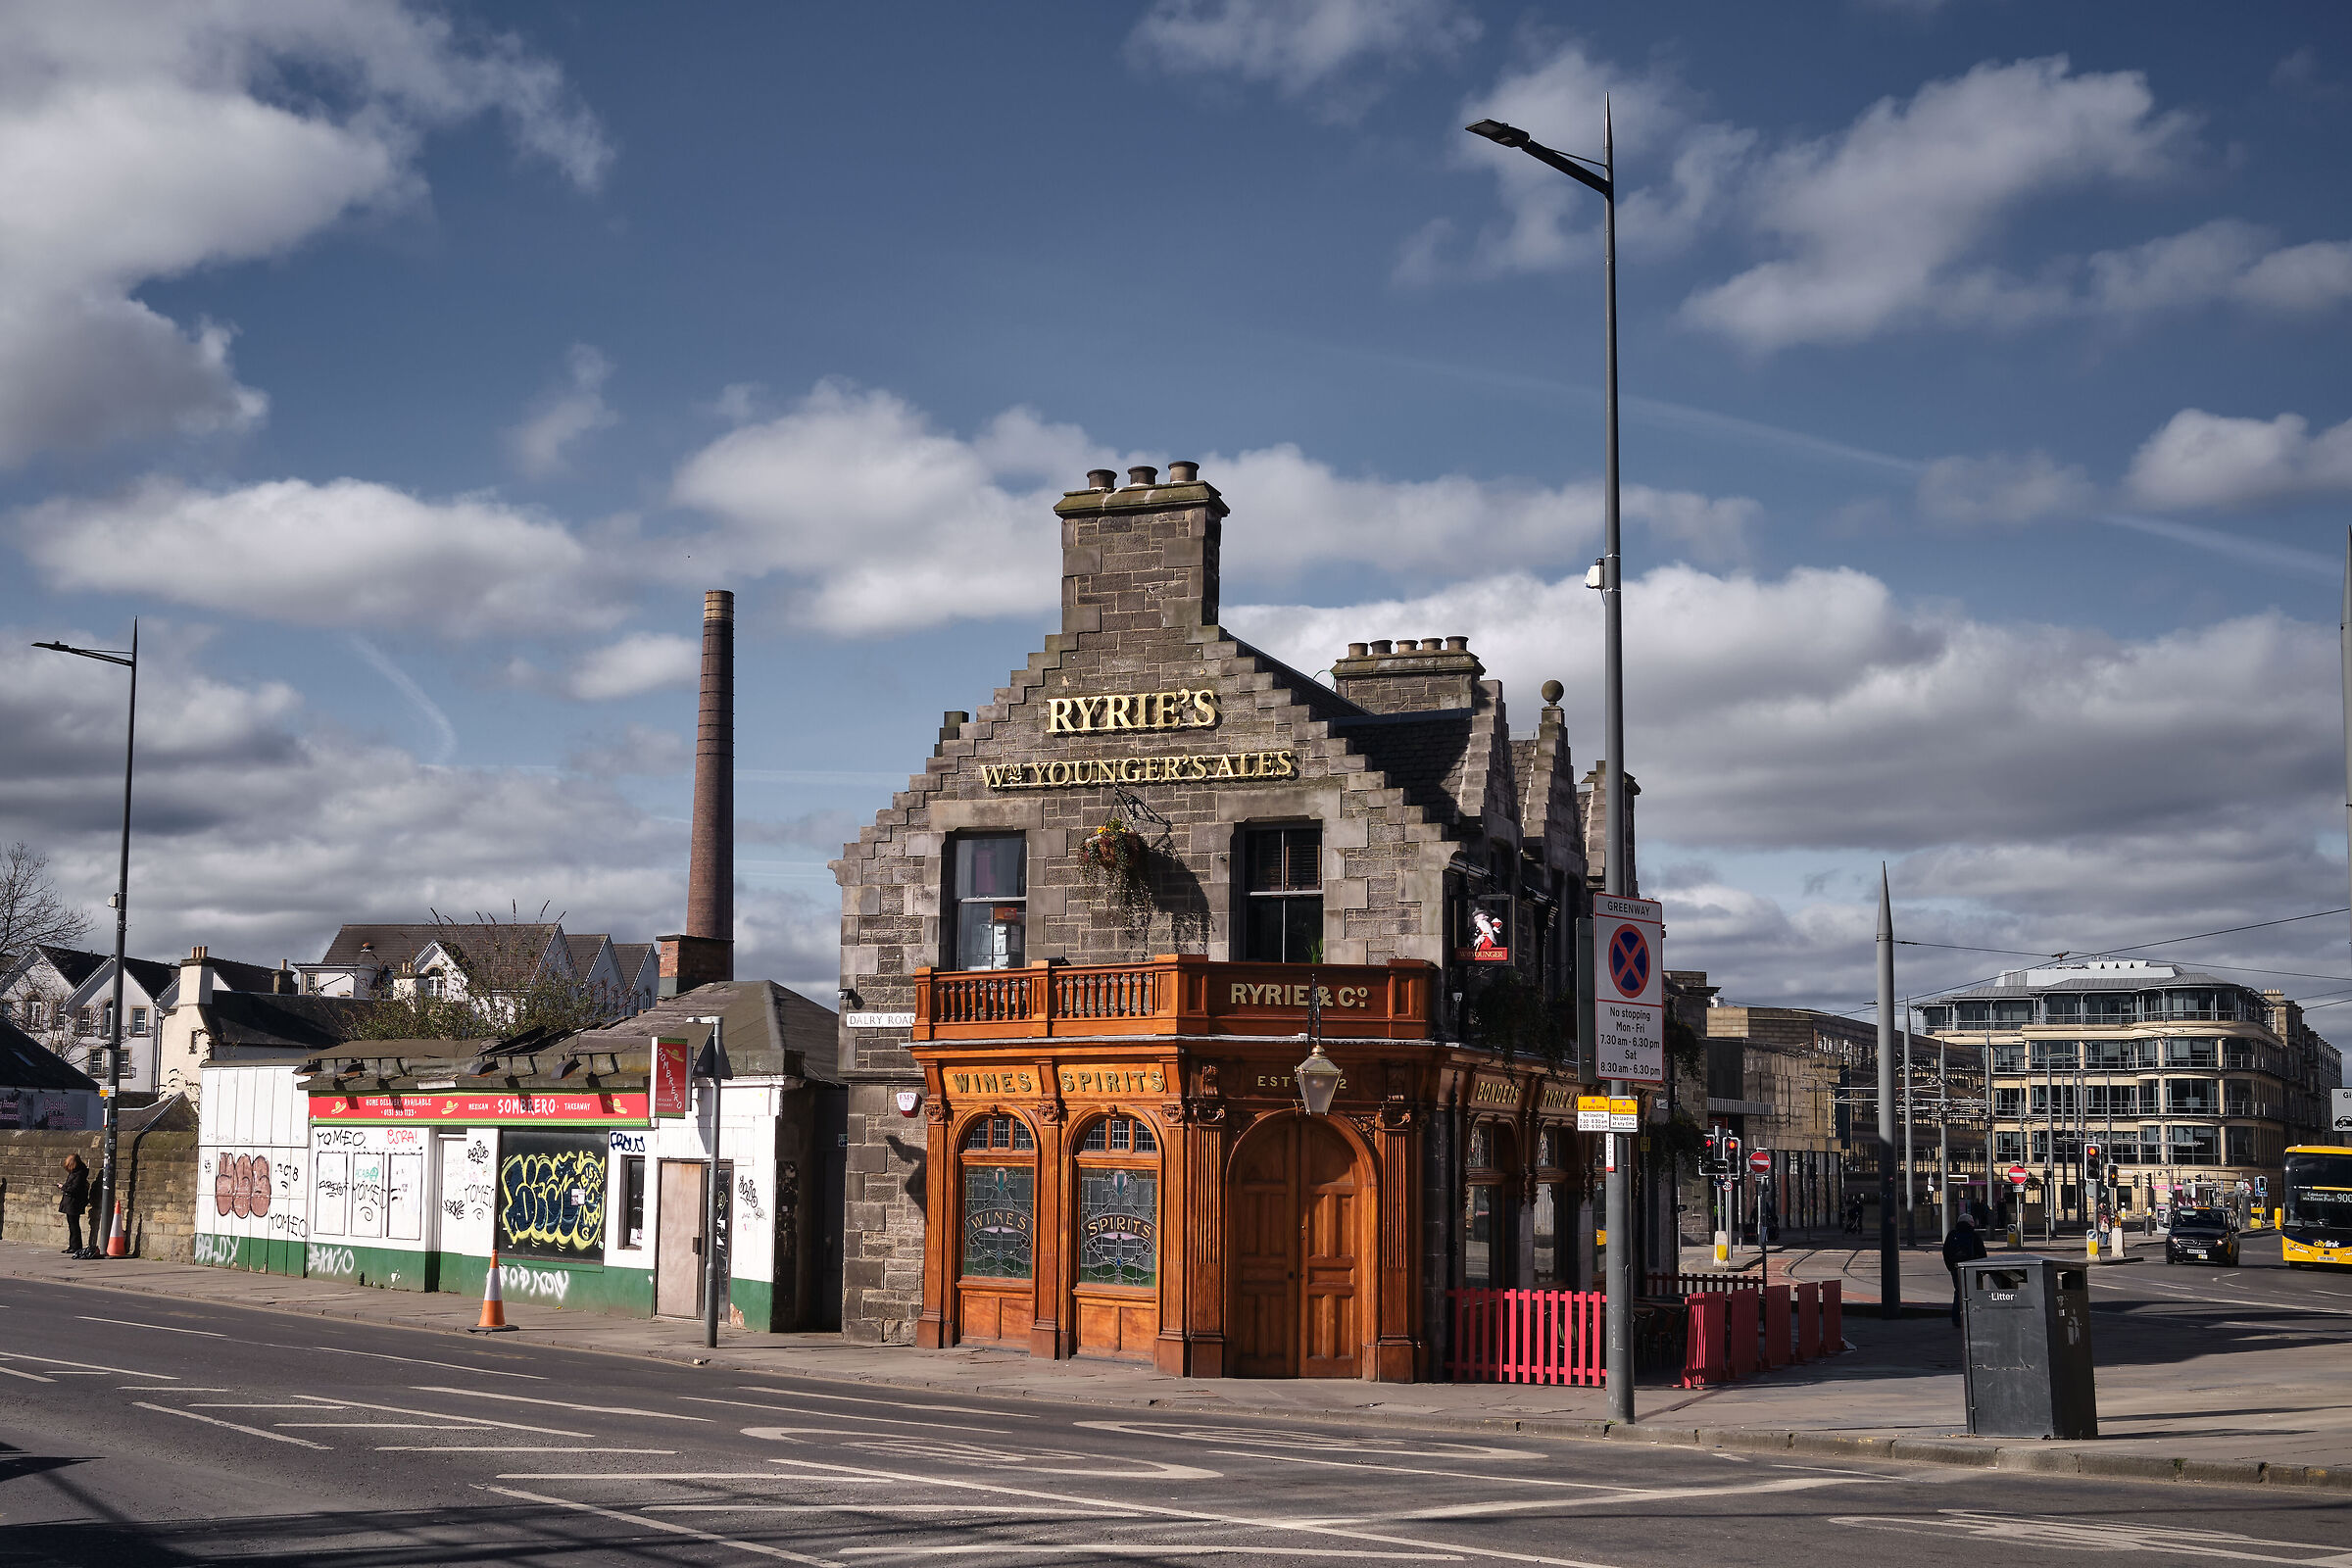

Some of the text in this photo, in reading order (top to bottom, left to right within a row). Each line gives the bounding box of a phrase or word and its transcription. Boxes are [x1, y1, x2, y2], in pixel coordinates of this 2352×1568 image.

[1046, 688, 1217, 734] RYRIE'S
[1031, 754, 1208, 786] YOUNGER'S
[1216, 750, 1293, 778] ALES
[1607, 901, 1650, 917] GREENWAY
[1230, 982, 1310, 1006] RYRIE
[1317, 985, 1334, 1007] &
[849, 1015, 883, 1025] DALRY
[1609, 1005, 1651, 1022] No stopping
[1616, 1021, 1631, 1032] Mon
[1636, 1023, 1645, 1034] Fri
[1600, 1034, 1616, 1045] 7.30
[1617, 1037, 1628, 1046] am
[1632, 1037, 1649, 1048] 6.30
[1625, 1049, 1638, 1059] Sat
[1600, 1062, 1617, 1073] 8.30
[1618, 1064, 1629, 1073] am
[1633, 1064, 1649, 1075] 6.30
[952, 1070, 1032, 1094] WINES
[1060, 1069, 1166, 1093] SPIRITS
[1477, 1081, 1520, 1105] BONDERS
[1542, 1089, 1567, 1108] RYRIE
[404, 1098, 431, 1107] AVAILABLE
[468, 1098, 591, 1116] MEXICAN SOMBRERO TAKEAWAY
[971, 1211, 1026, 1231] WINES
[1088, 1216, 1152, 1238] SPIRITS
[2313, 1240, 2340, 1249] citylink
[1990, 1292, 2015, 1301] Litter
